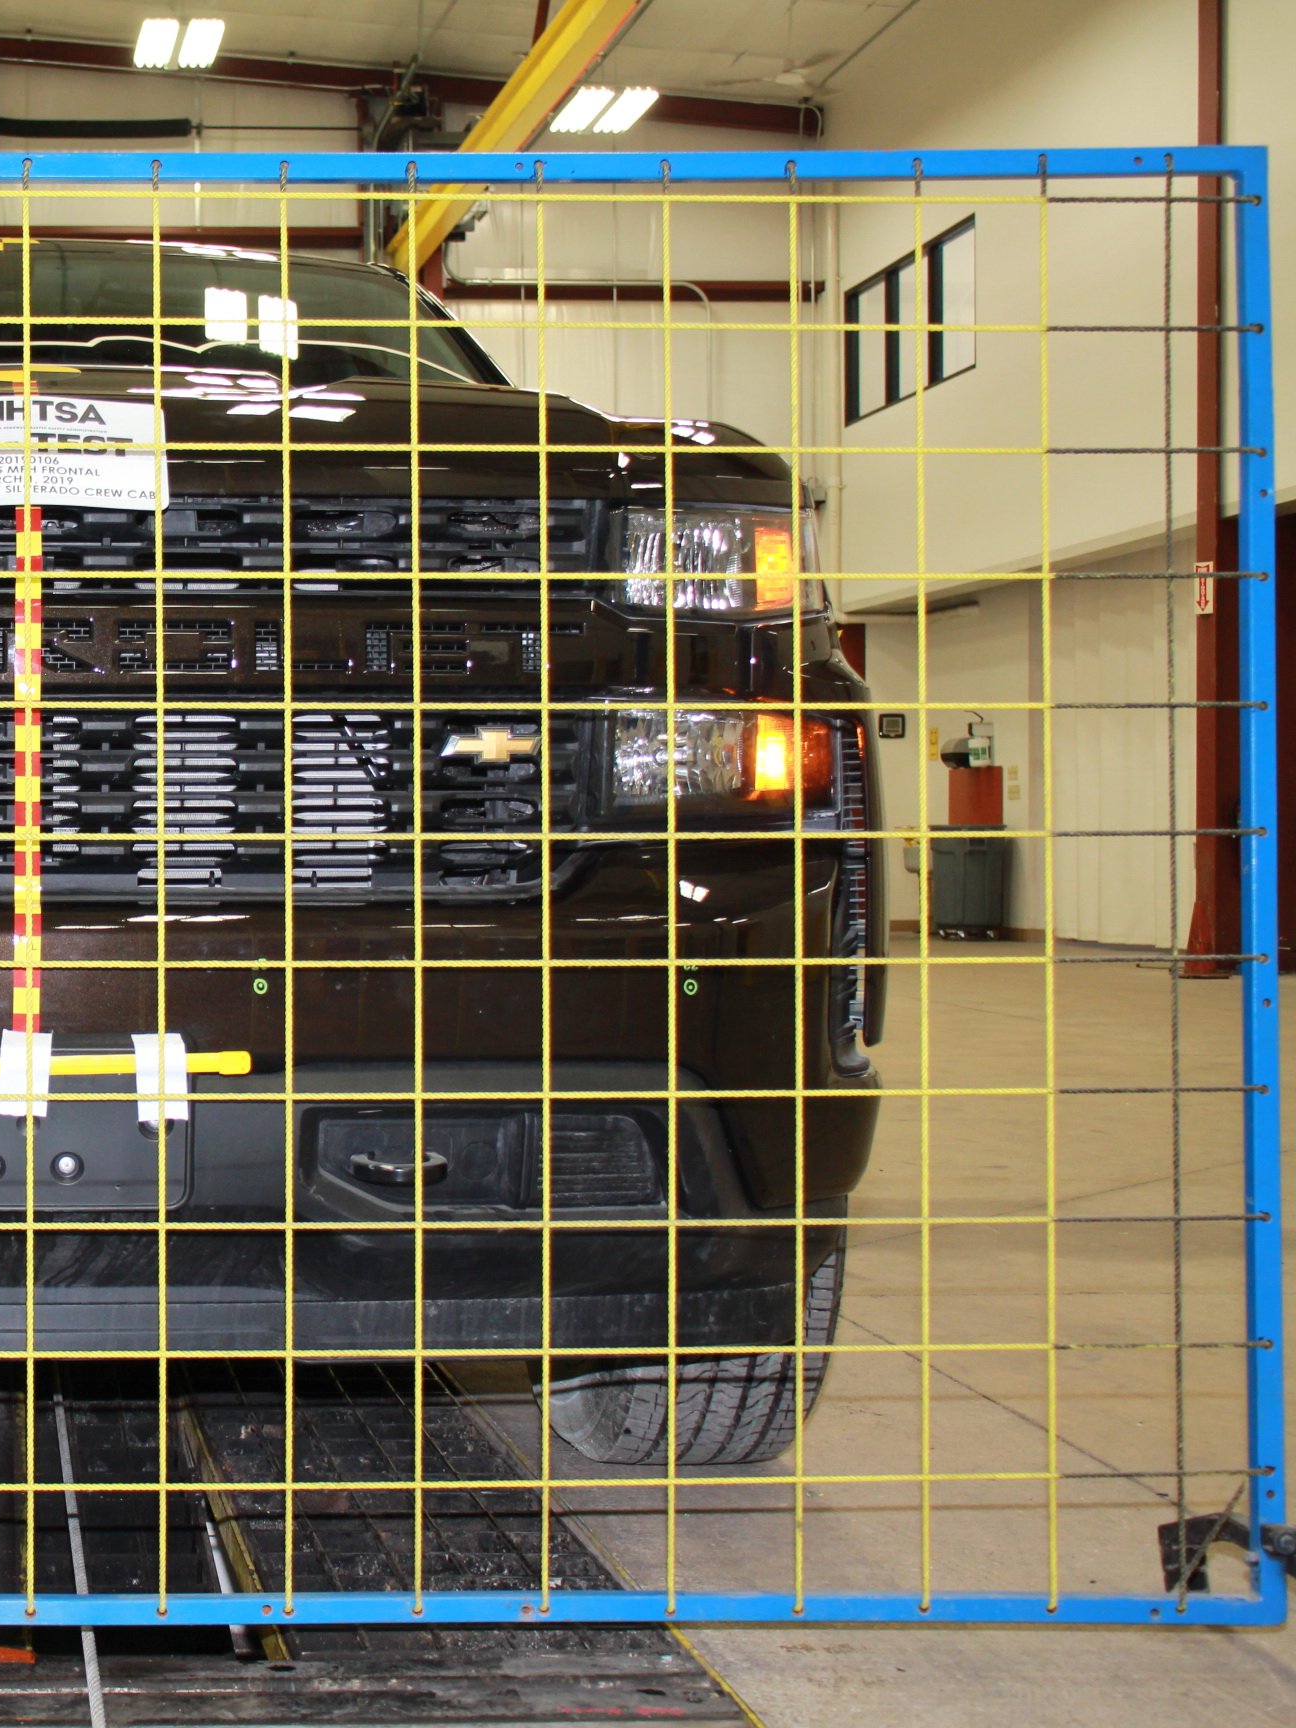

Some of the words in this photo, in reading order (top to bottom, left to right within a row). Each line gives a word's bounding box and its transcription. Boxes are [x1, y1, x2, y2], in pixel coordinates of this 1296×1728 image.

[42, 466, 101, 477] FRONTAL
[43, 475, 74, 486] 2019
[84, 487, 123, 498] CREW
[127, 489, 156, 500] CAB
